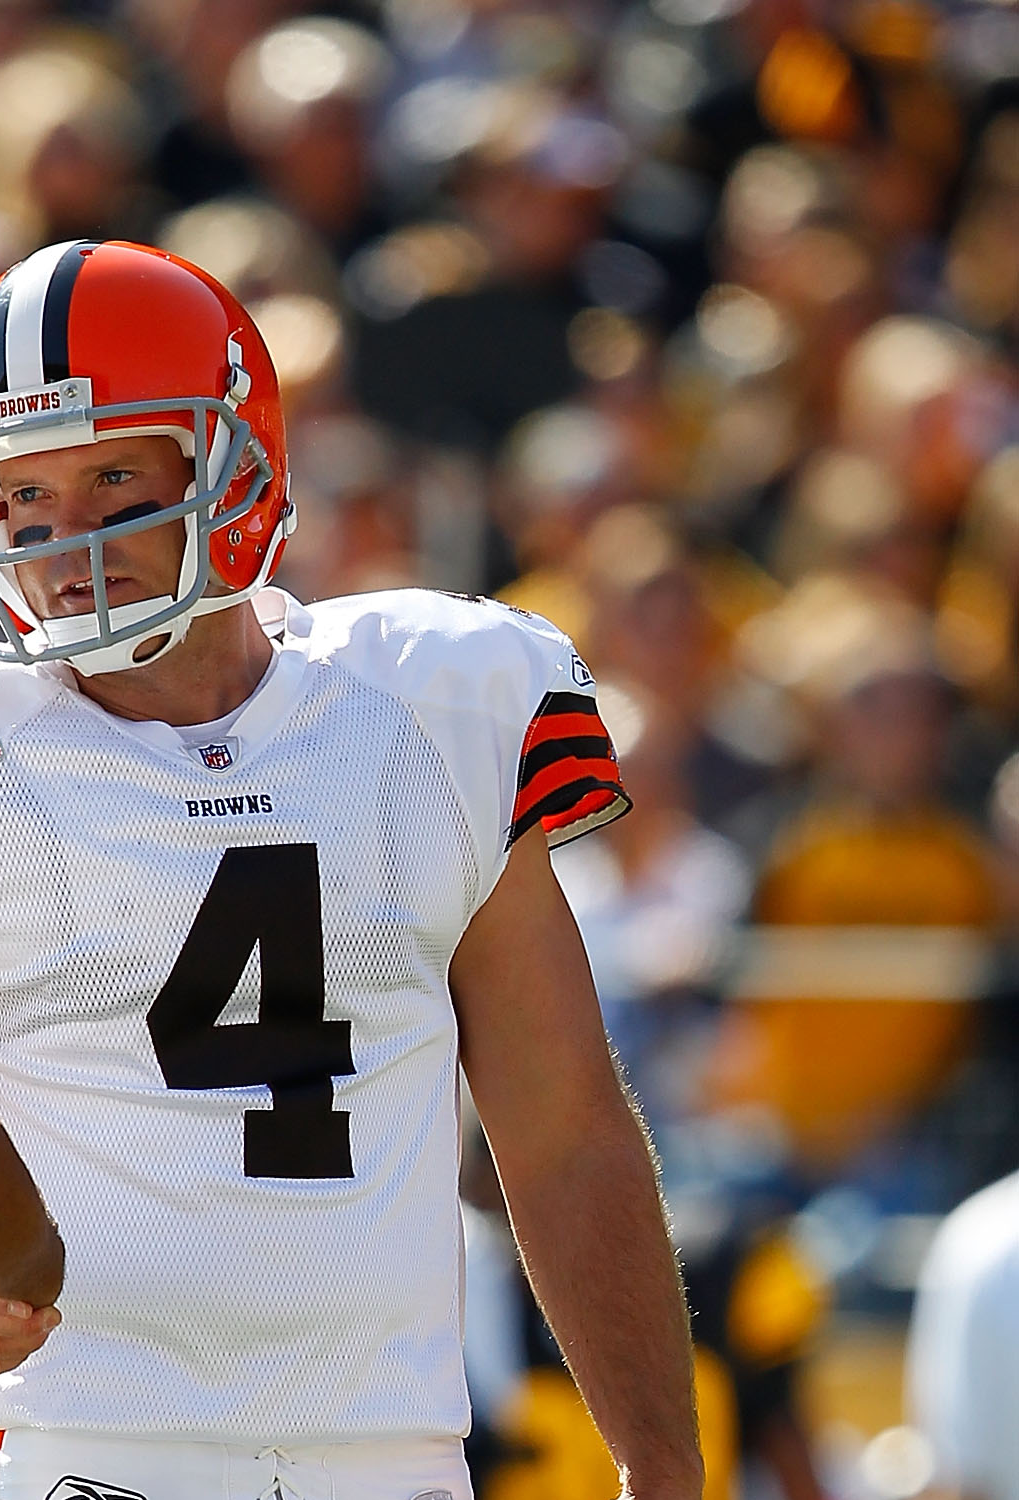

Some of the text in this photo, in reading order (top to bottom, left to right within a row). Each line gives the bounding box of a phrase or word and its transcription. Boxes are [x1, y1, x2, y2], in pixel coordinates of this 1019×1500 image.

[0, 391, 61, 418] BROWNS
[185, 794, 273, 817] BROWNS
[146, 842, 358, 1180] 4
